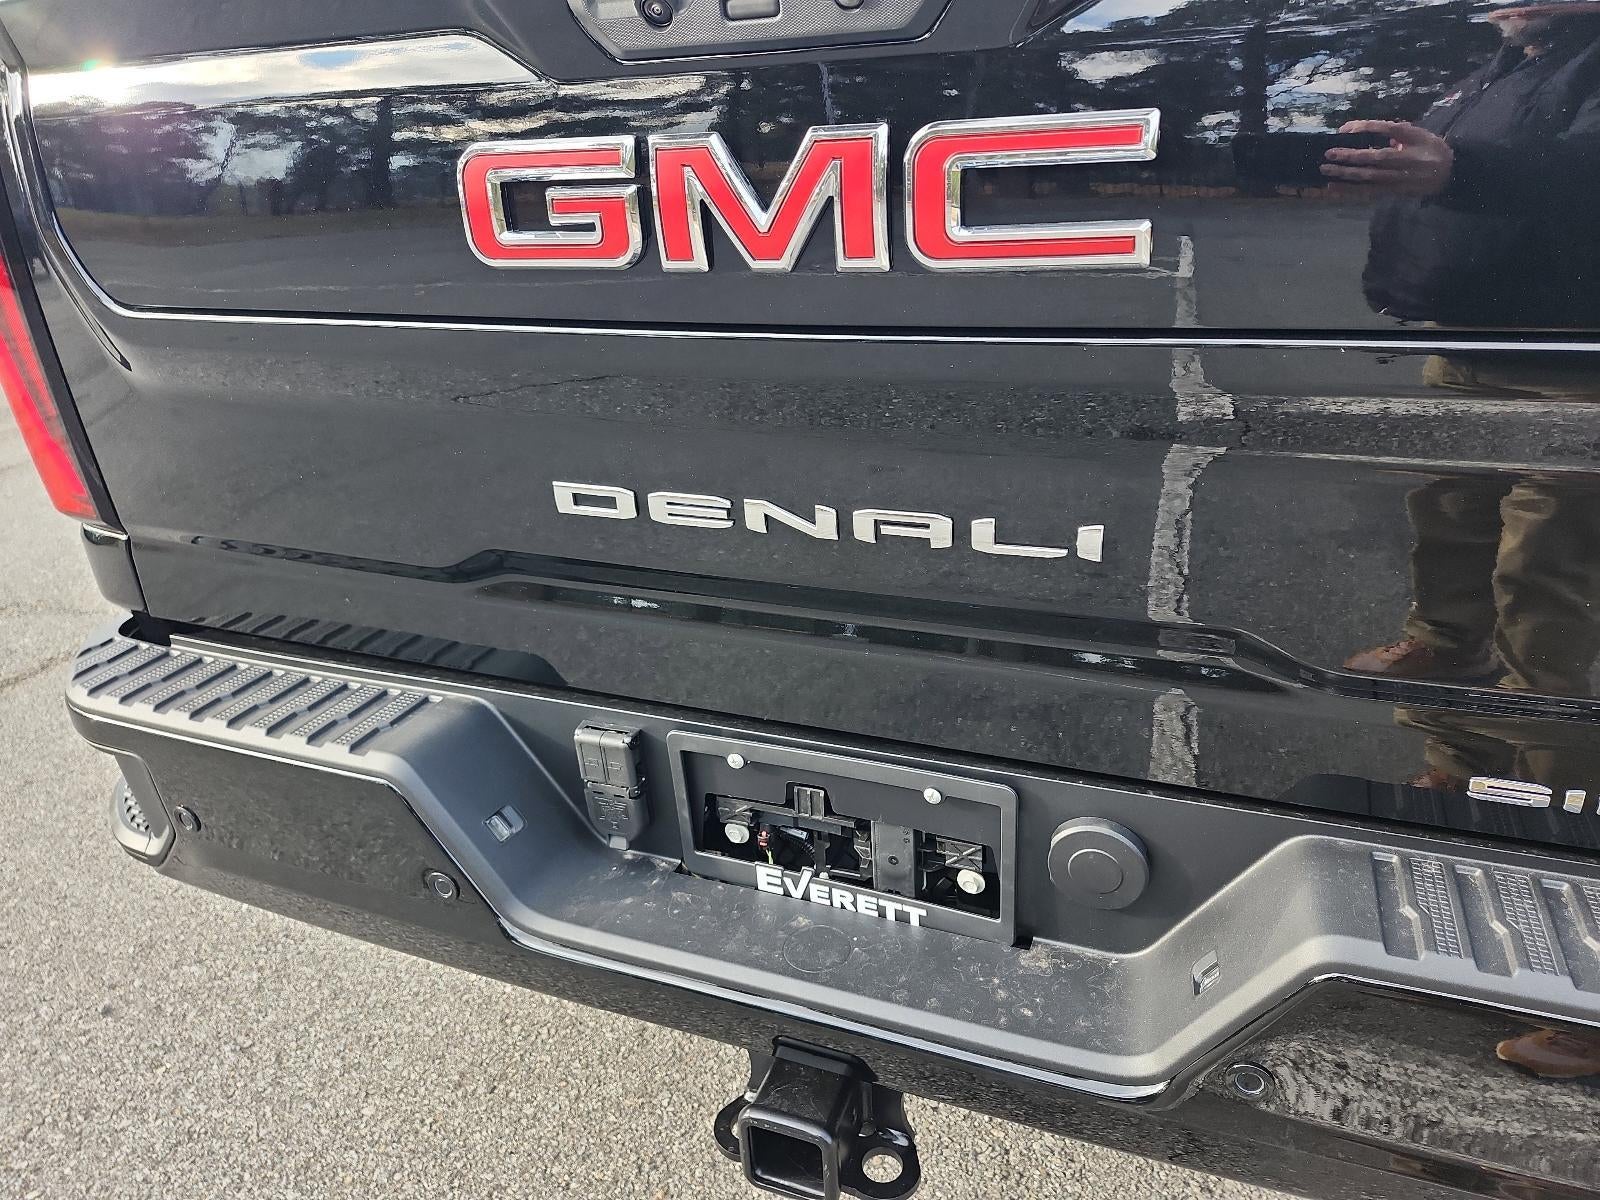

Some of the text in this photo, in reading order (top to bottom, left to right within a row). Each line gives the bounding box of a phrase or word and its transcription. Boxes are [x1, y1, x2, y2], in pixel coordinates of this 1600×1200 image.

[457, 107, 1161, 273] GMC
[552, 480, 1105, 563] DENALI
[1466, 776, 1600, 816] SI
[755, 863, 927, 927] EVERETT
